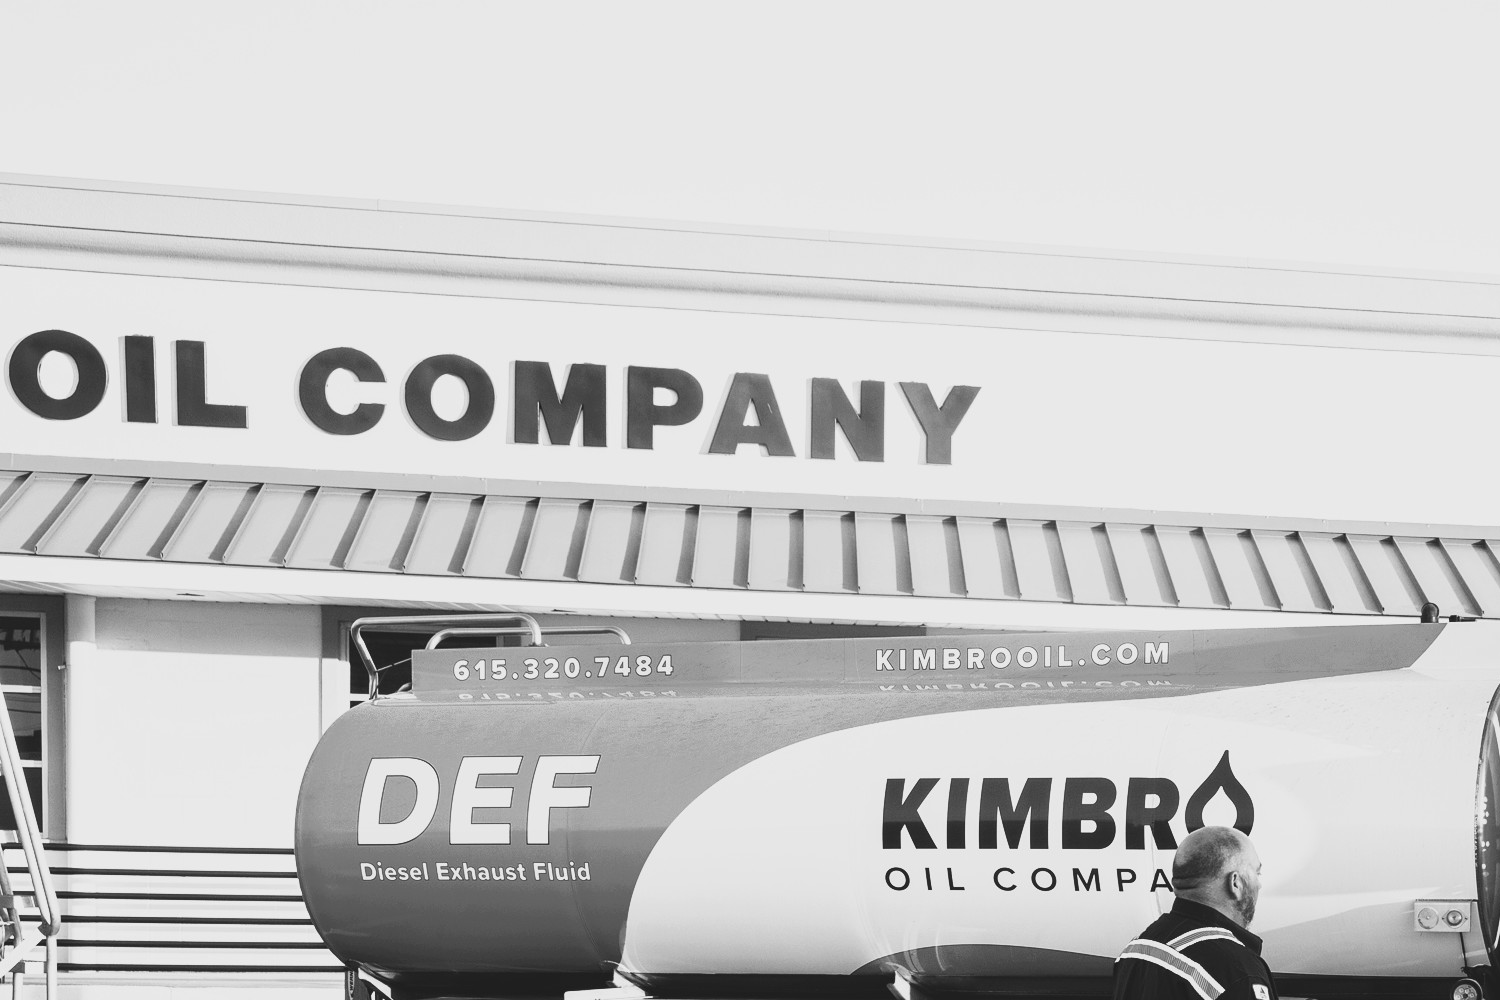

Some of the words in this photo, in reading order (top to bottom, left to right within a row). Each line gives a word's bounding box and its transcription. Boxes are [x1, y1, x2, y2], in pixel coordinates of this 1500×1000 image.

[7, 329, 249, 429] OIL
[296, 346, 982, 465] COMPANY
[452, 654, 674, 681] 615.320.7484
[875, 641, 1170, 671] KIMBROOIL.COM
[356, 754, 601, 846] DEF
[882, 749, 1255, 850] KIMBRO
[360, 863, 428, 881] Diesel
[436, 863, 527, 881] Exhaust
[533, 863, 591, 881] Fluid
[884, 867, 965, 891] OIL
[993, 867, 1174, 893] COMPA
